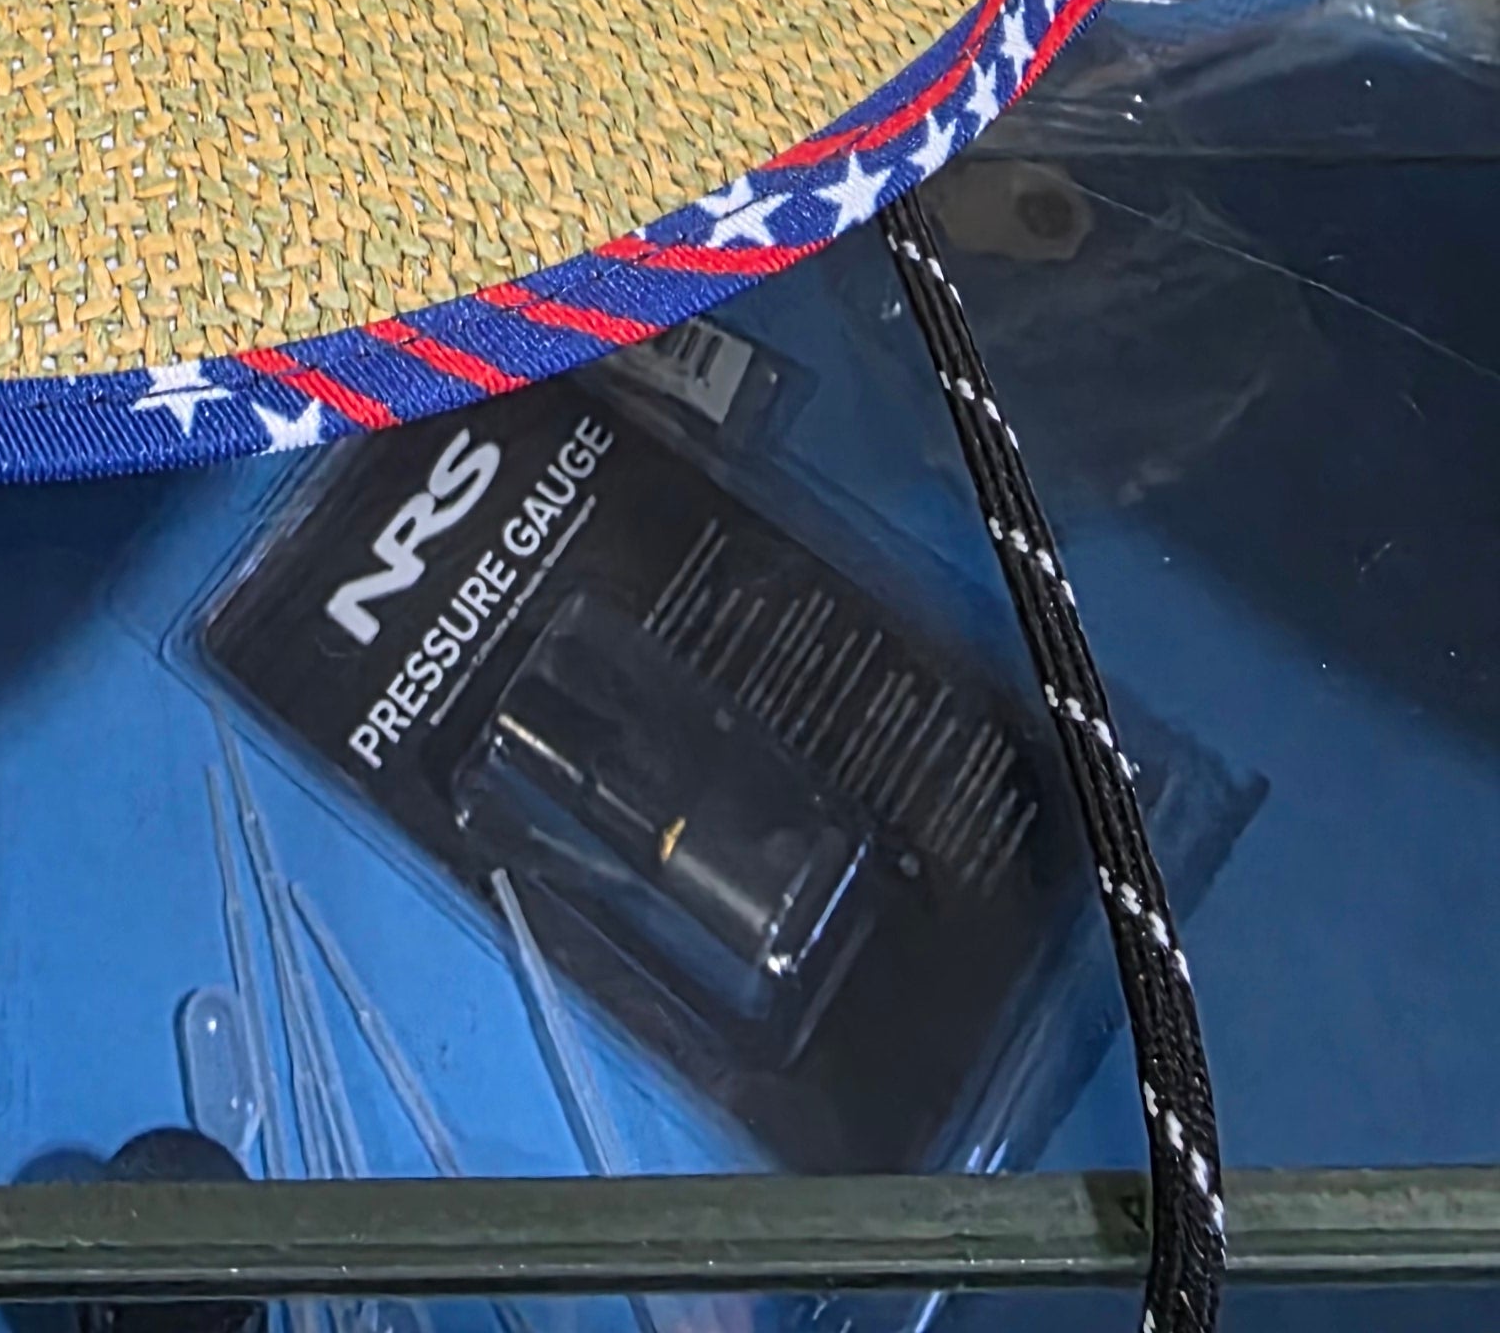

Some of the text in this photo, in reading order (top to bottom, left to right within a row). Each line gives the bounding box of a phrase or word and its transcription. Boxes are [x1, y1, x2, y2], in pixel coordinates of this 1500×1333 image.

[325, 427, 501, 646] NRS
[349, 415, 614, 770] PRESSURE GAUGE
